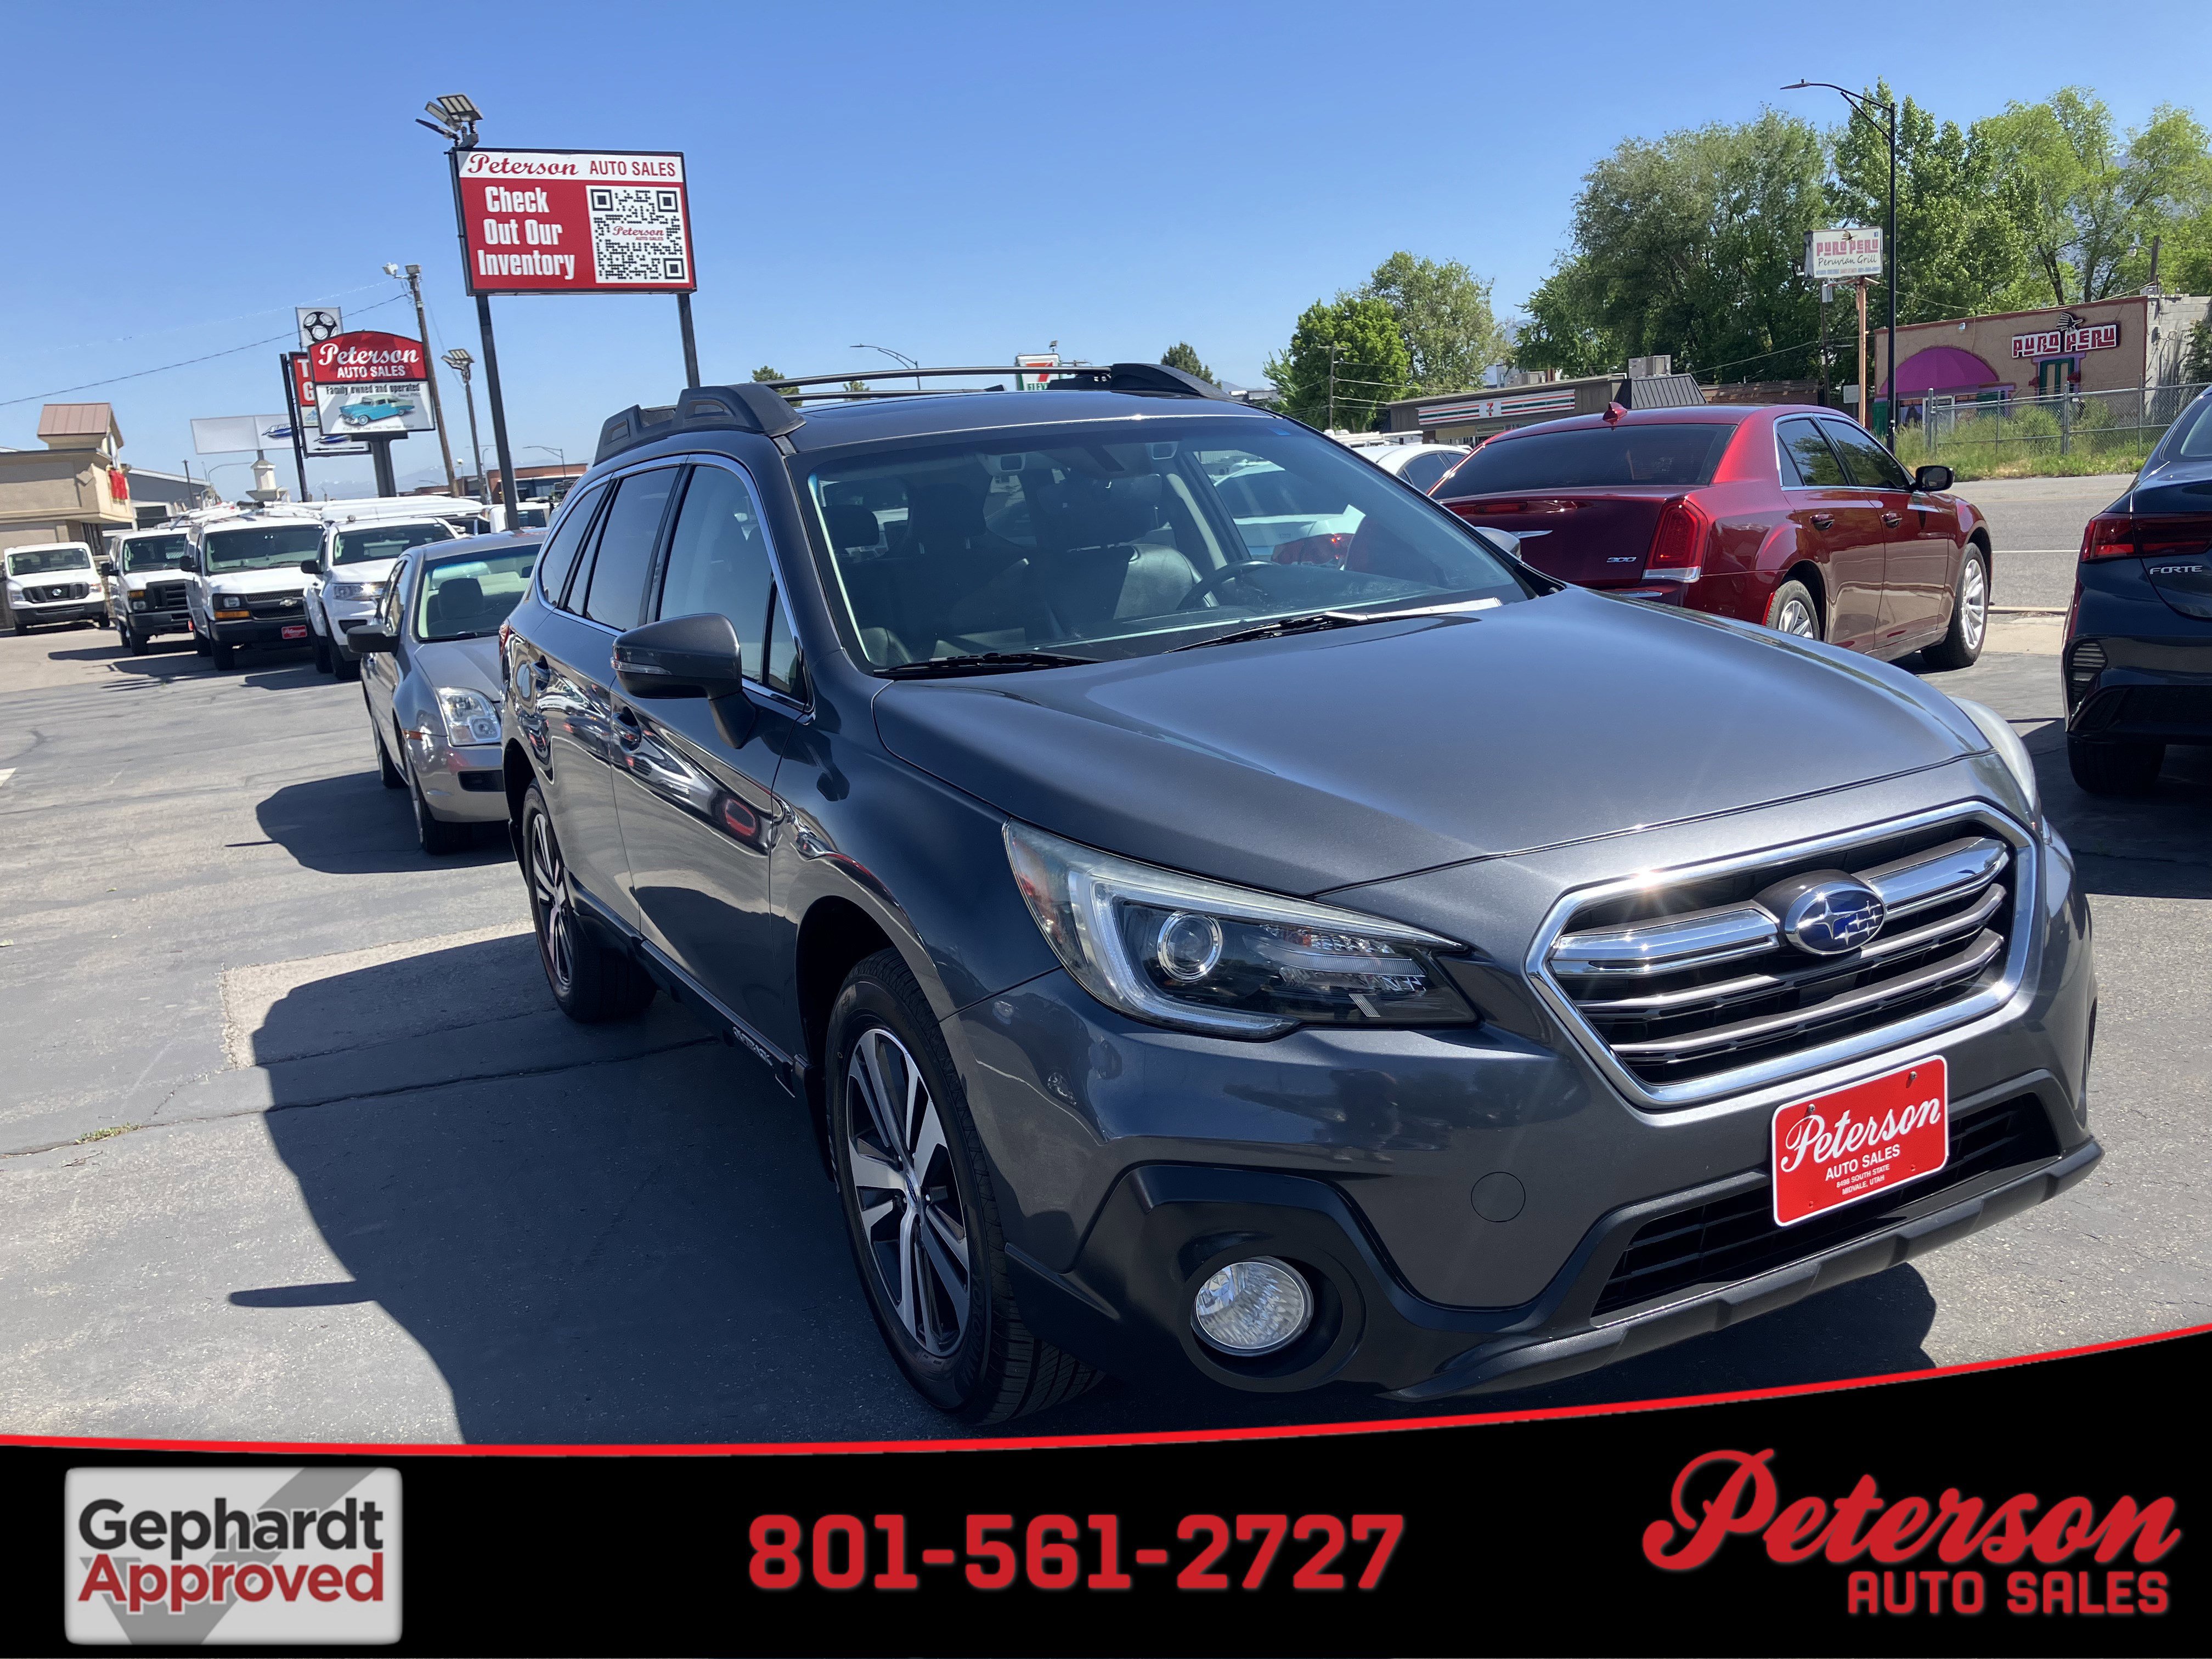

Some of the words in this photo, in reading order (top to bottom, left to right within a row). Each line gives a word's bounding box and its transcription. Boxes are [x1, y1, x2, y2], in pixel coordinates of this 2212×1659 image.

[468, 154, 579, 176] Peterson
[589, 161, 627, 175] AUTO
[633, 161, 675, 177] SALES
[484, 185, 550, 213] Check
[483, 218, 520, 245] Out
[524, 219, 563, 246] Our
[612, 226, 664, 236] Peterson
[1849, 239, 1878, 254] PERU
[477, 250, 575, 280] Inventory
[1818, 257, 1855, 267] Peruvian
[1857, 255, 1877, 264] Grill
[2012, 331, 2061, 358] PURO
[2065, 325, 2117, 352] PERU
[318, 343, 419, 365] Peterson
[337, 366, 367, 378] AUTO
[370, 365, 405, 377] SALES
[2149, 565, 2203, 575] FORTE
[1780, 1098, 1942, 1172] Peterson
[1825, 1159, 1859, 1181] AUTO
[1861, 1144, 1901, 1168] SALES
[1851, 1170, 1871, 1183] SOUTH
[1872, 1164, 1890, 1175] STATE
[1870, 1174, 1884, 1185] UTAH
